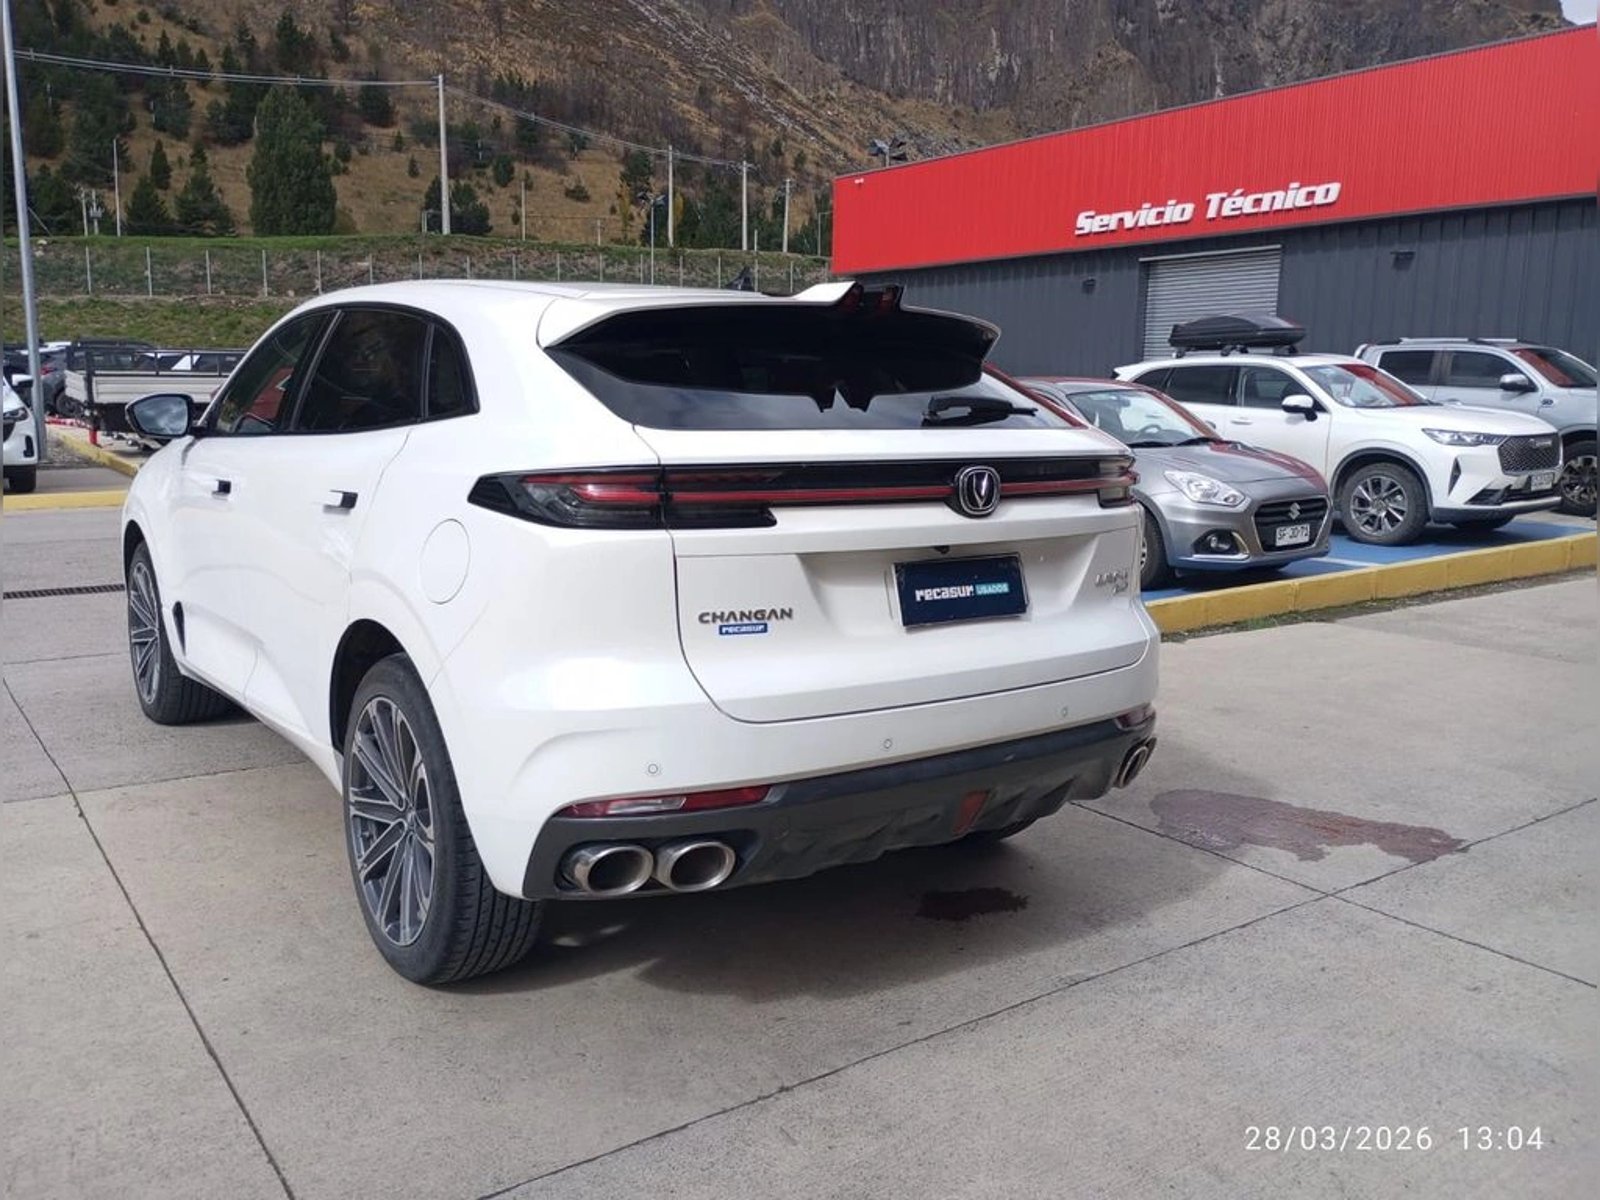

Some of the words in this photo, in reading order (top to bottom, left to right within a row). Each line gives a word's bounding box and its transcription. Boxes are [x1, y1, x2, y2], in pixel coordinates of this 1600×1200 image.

[1074, 199, 1195, 236] Servicio
[1205, 182, 1342, 220] Técnico
[915, 584, 974, 602] recasur
[698, 607, 793, 624] CHANGAN
